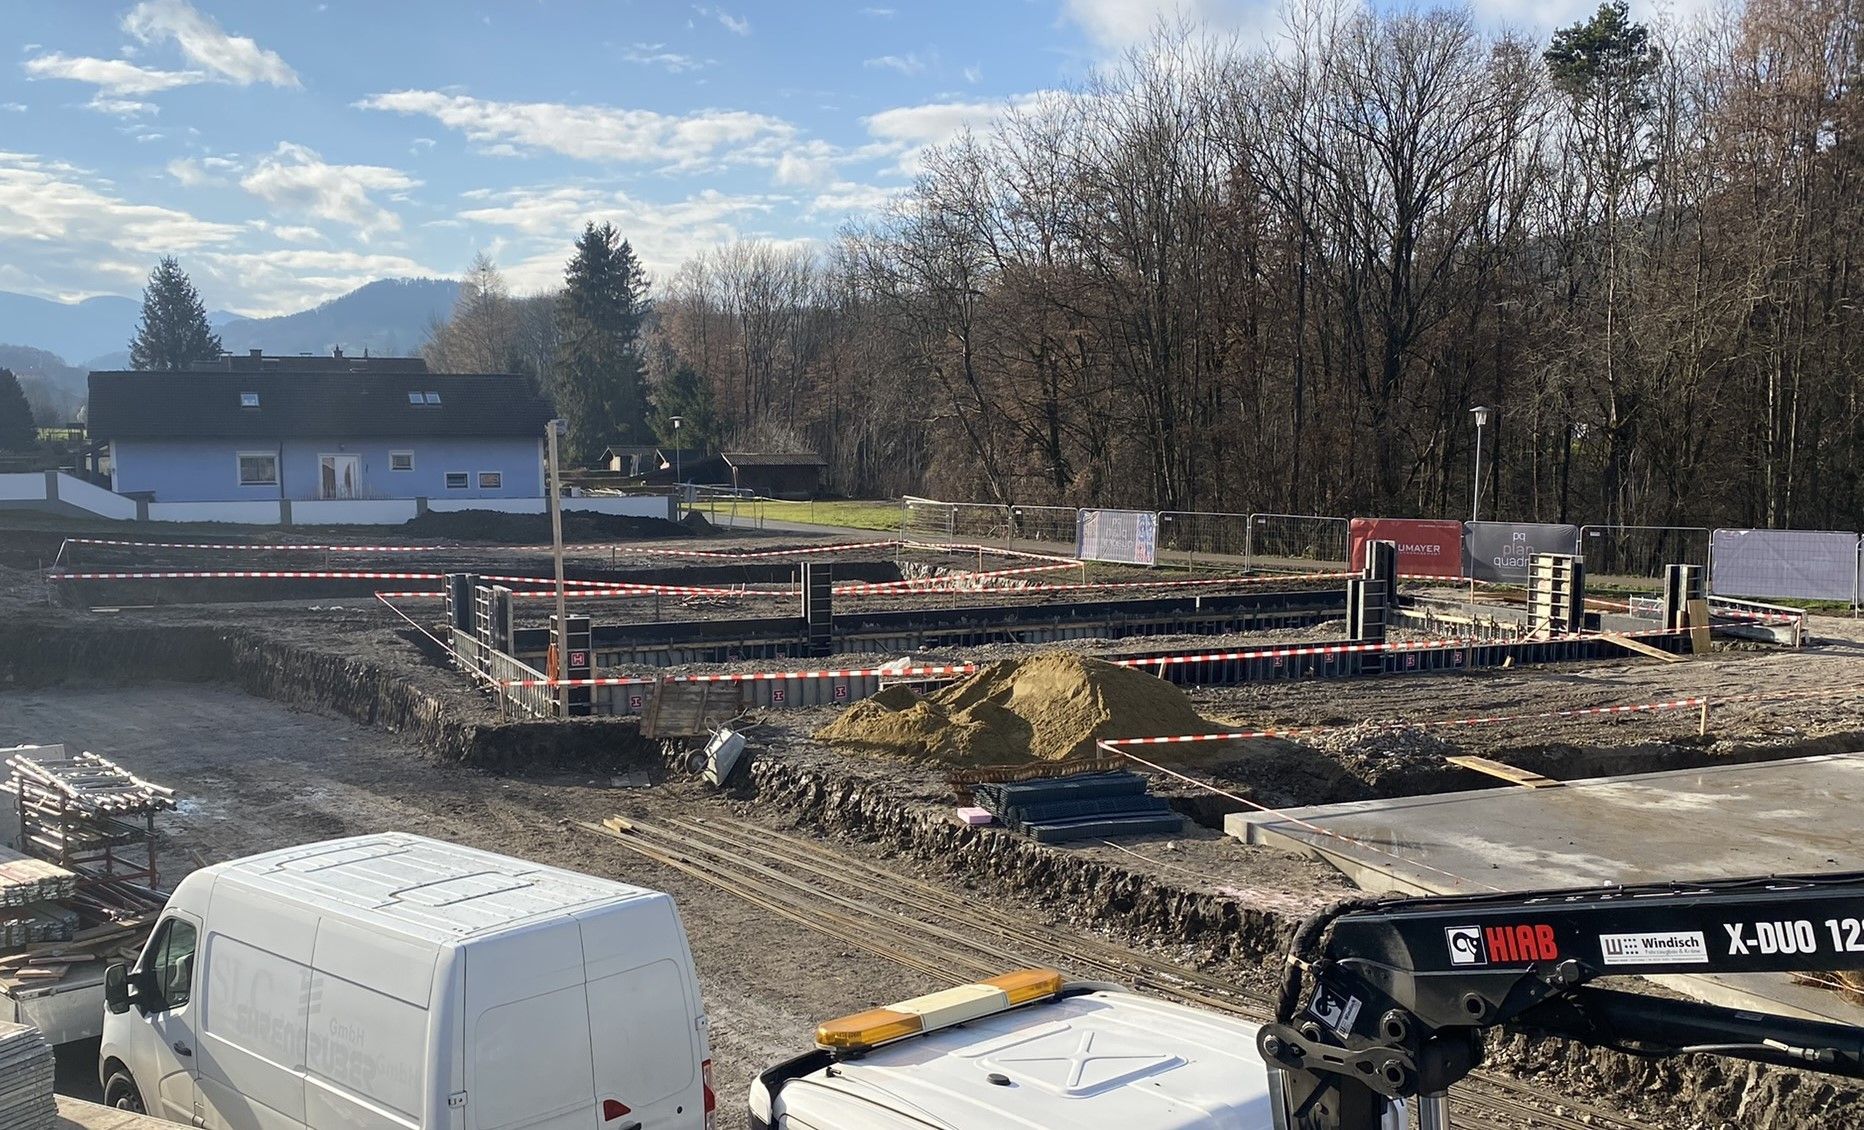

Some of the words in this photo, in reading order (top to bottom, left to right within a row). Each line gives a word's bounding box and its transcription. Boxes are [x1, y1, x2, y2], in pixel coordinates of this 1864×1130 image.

[1513, 532, 1526, 542] pq
[1397, 543, 1441, 553] UMAYER
[1503, 543, 1535, 557] plan
[1493, 556, 1529, 569] quadr
[1485, 924, 1558, 962] HIAB
[1641, 936, 1700, 949] Windisch
[1723, 920, 1817, 955] X-DUO
[1824, 918, 1864, 952] 12
[329, 1017, 365, 1047] GmbH
